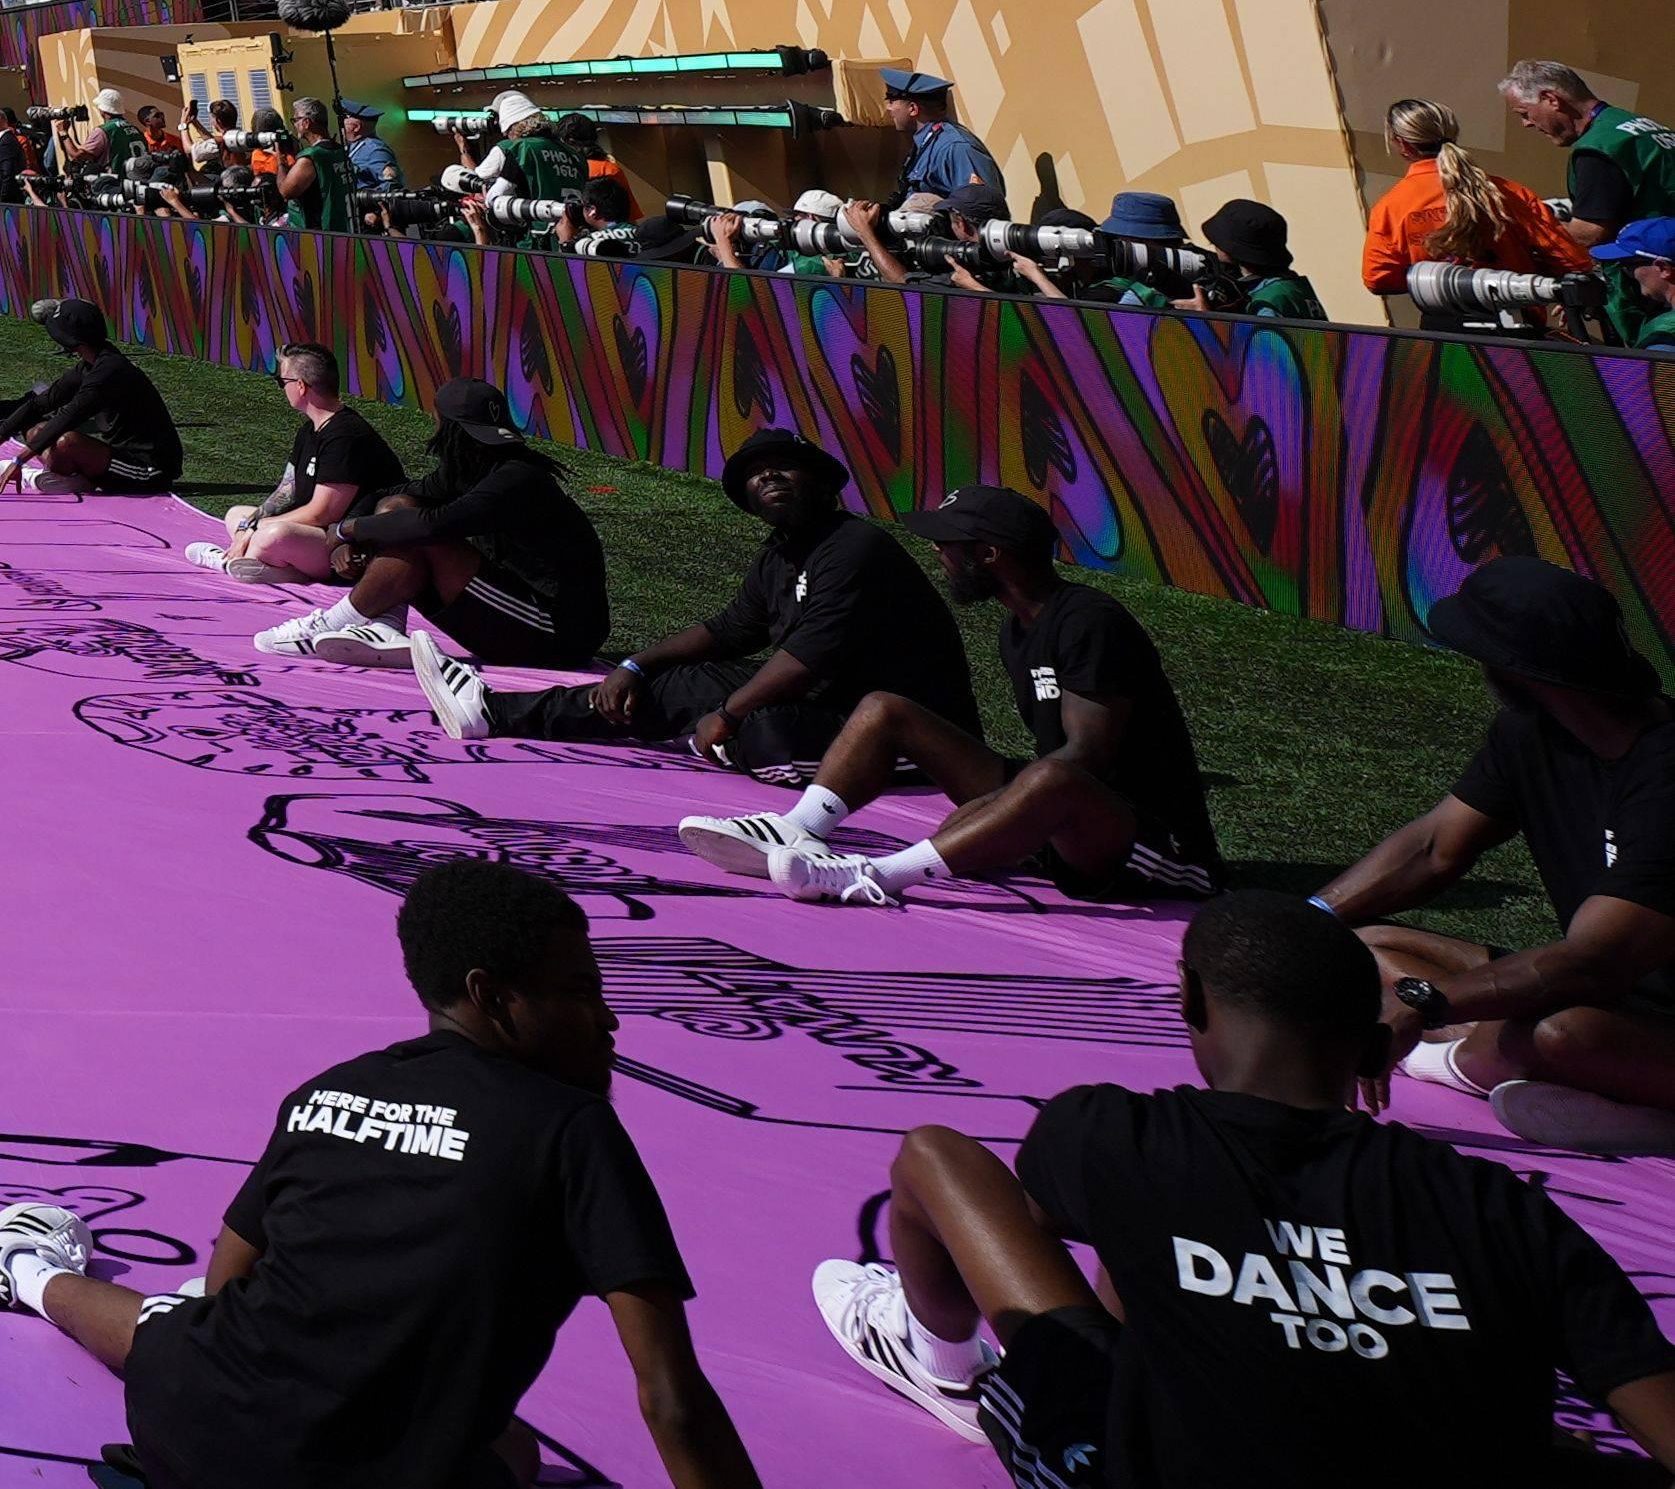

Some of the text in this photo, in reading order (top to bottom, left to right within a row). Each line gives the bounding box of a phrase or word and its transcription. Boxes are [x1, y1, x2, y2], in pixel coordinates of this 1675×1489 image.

[309, 1090, 457, 1127] HERE FOR THE
[287, 1105, 469, 1161] HALFTIME
[1265, 1219, 1351, 1265] WE
[1172, 1236, 1470, 1331] DANCE
[1270, 1312, 1389, 1360] TOO
